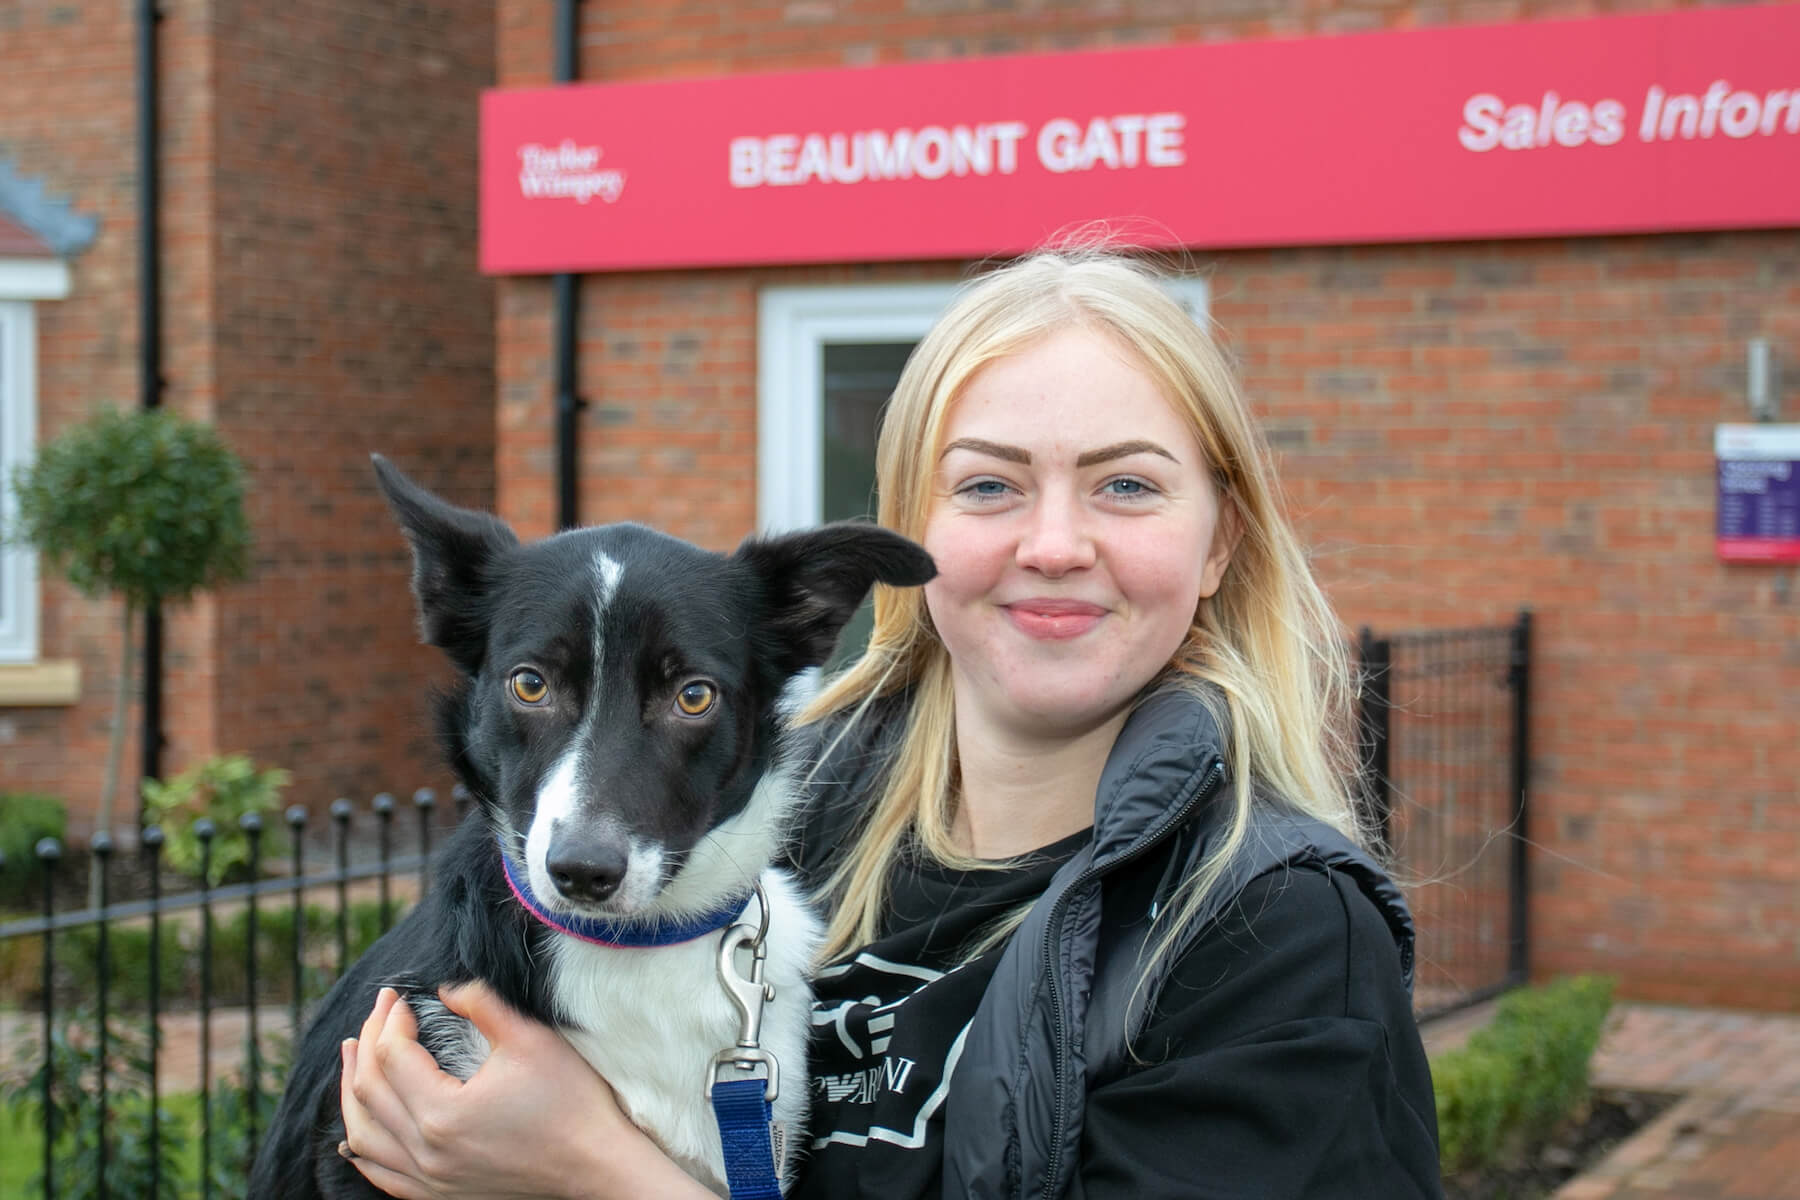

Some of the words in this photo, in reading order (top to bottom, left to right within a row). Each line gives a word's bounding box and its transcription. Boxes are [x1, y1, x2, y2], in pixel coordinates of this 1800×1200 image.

[730, 121, 1026, 188] BEAUMONT
[1036, 112, 1187, 173] GATE
[1458, 90, 1626, 152] Sales
